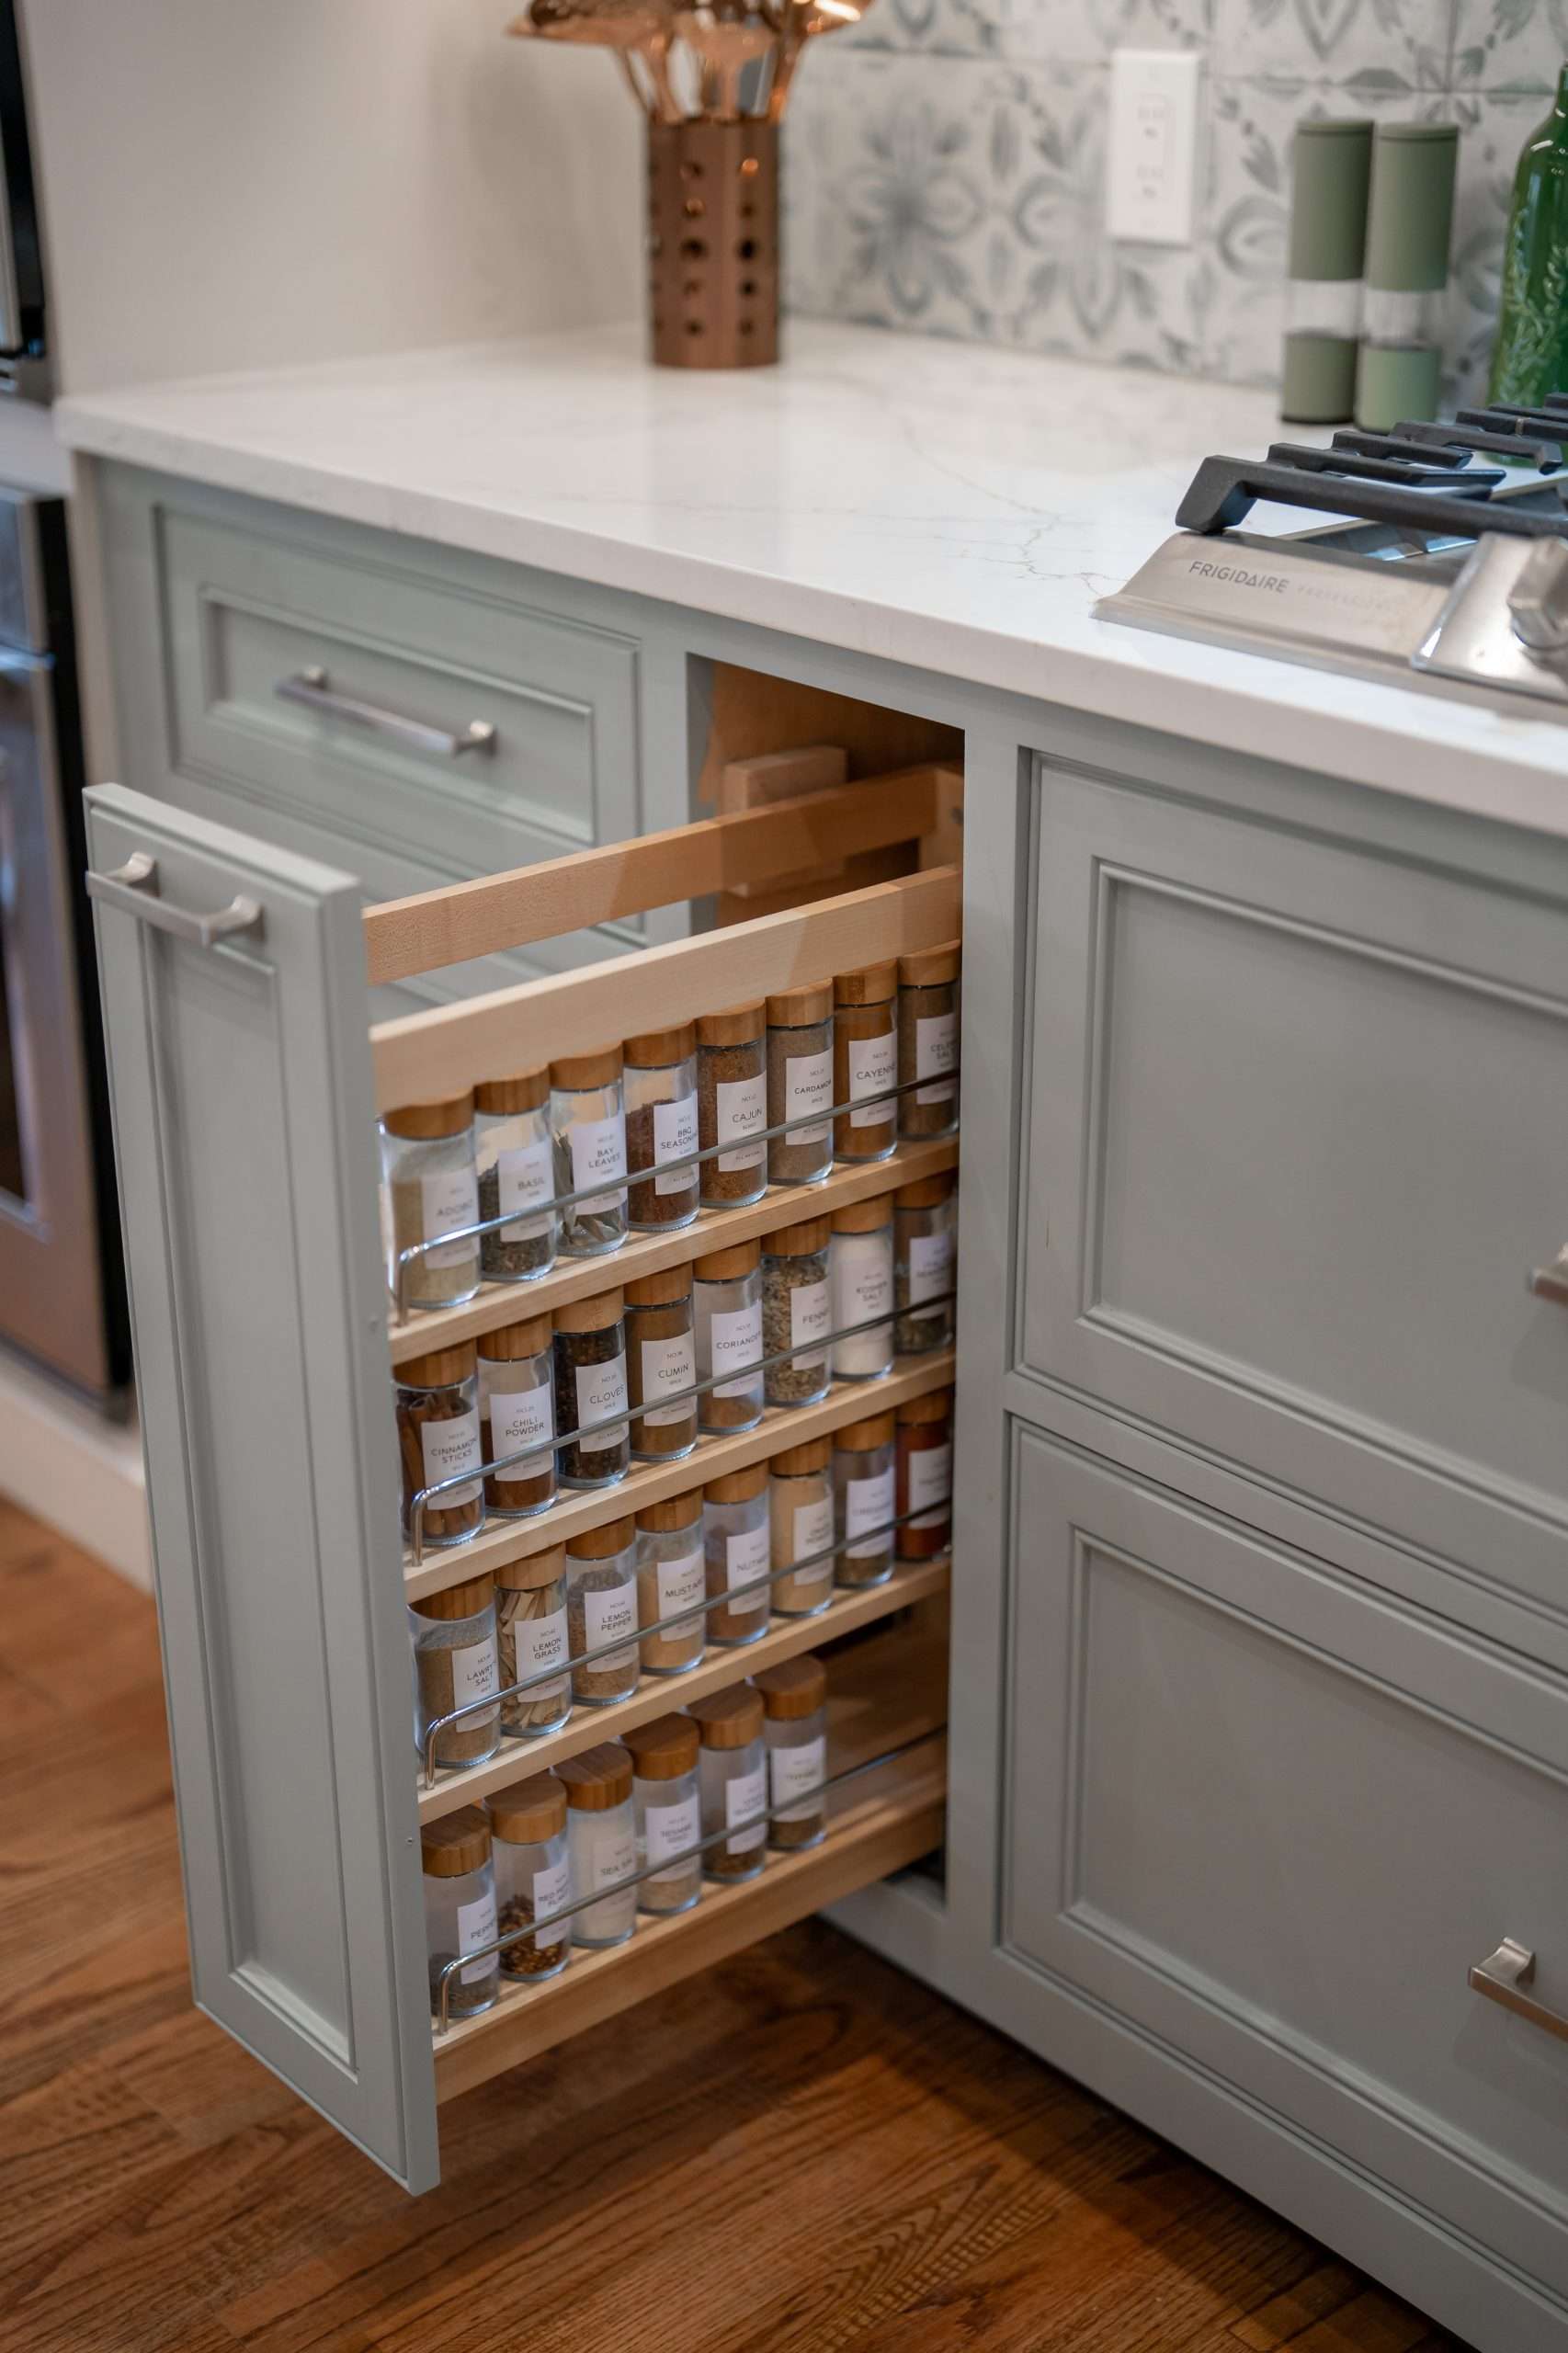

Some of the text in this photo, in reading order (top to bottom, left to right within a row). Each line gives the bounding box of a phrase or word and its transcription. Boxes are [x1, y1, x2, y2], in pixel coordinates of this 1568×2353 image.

[1188, 560, 1290, 594] FRIGIDAIRE
[732, 1107, 763, 1124] CAJUN
[660, 1131, 698, 1150] SEASON
[676, 1125, 692, 1139] BBQ
[597, 1146, 614, 1158] BAY
[587, 1153, 621, 1169] LEAVES
[517, 1175, 546, 1191] BASIL
[716, 1330, 762, 1351] CORIAND
[657, 1360, 690, 1380] CUMIN
[588, 1382, 625, 1405] CLOVES
[506, 1421, 545, 1438] POWDER
[512, 1415, 539, 1429] CHILI
[441, 1448, 472, 1465] STICKS
[600, 1615, 632, 1632] PEPPER
[601, 1609, 631, 1624] LEMON
[532, 1636, 562, 1653] LEMON
[534, 1645, 562, 1661] GRASS
[474, 1670, 494, 1688] SALT
